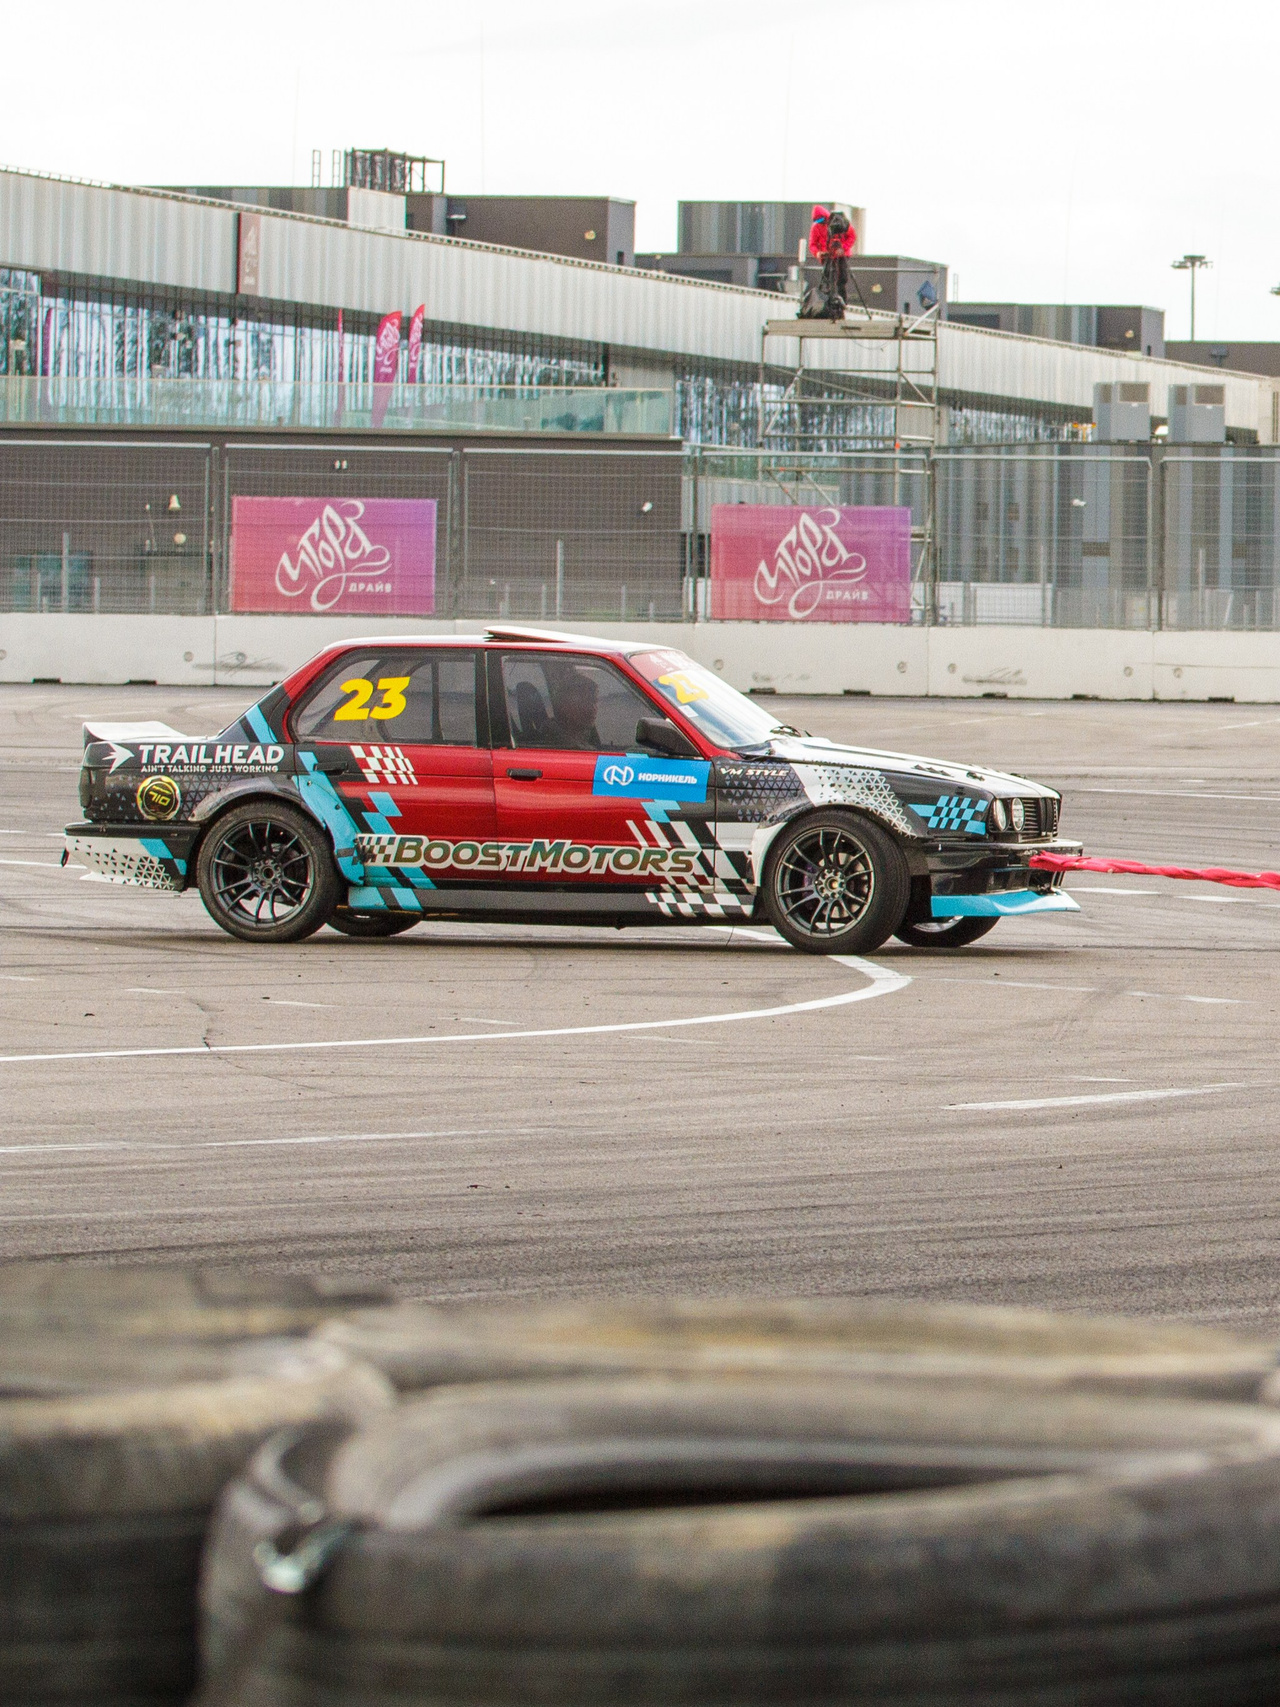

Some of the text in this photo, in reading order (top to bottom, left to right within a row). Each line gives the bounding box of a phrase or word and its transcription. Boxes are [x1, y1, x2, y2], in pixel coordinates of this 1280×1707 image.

[348, 582, 392, 593] ДРАЙВ
[826, 590, 869, 601] ДРАЙВ
[333, 676, 411, 721] 23
[138, 744, 285, 764] TRAILHEAD
[140, 765, 279, 773] AIN'T TALKING JUST WORKING
[719, 767, 789, 777] VM STYLE
[637, 772, 698, 785] НОРНИКЕЛЬ
